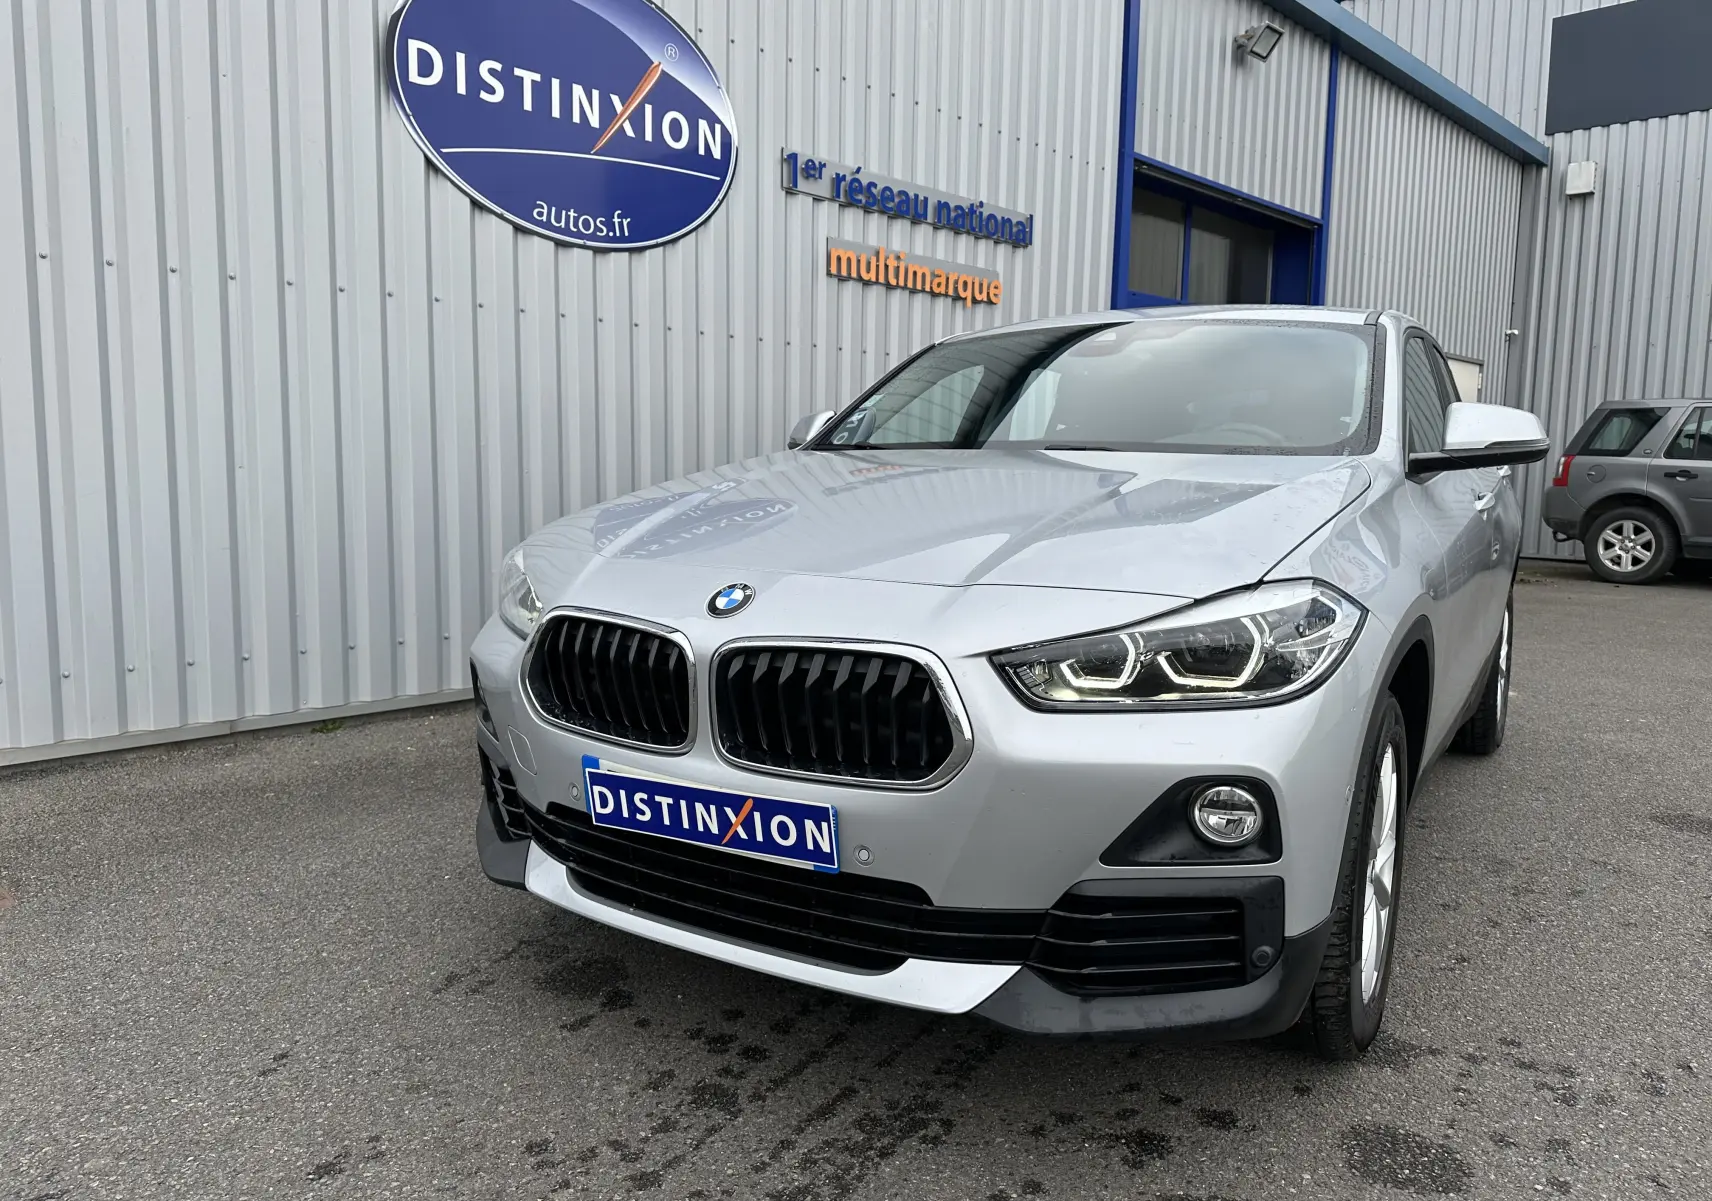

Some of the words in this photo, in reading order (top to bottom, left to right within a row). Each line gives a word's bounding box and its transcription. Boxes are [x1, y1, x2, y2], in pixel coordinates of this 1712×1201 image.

[407, 38, 722, 160] DISTINXION
[532, 200, 631, 237] autos.fr
[785, 152, 827, 189] 1er
[833, 166, 929, 220] réseau
[936, 201, 1034, 245] national
[830, 247, 1002, 308] multimarque
[591, 785, 832, 853] DISTINXION
